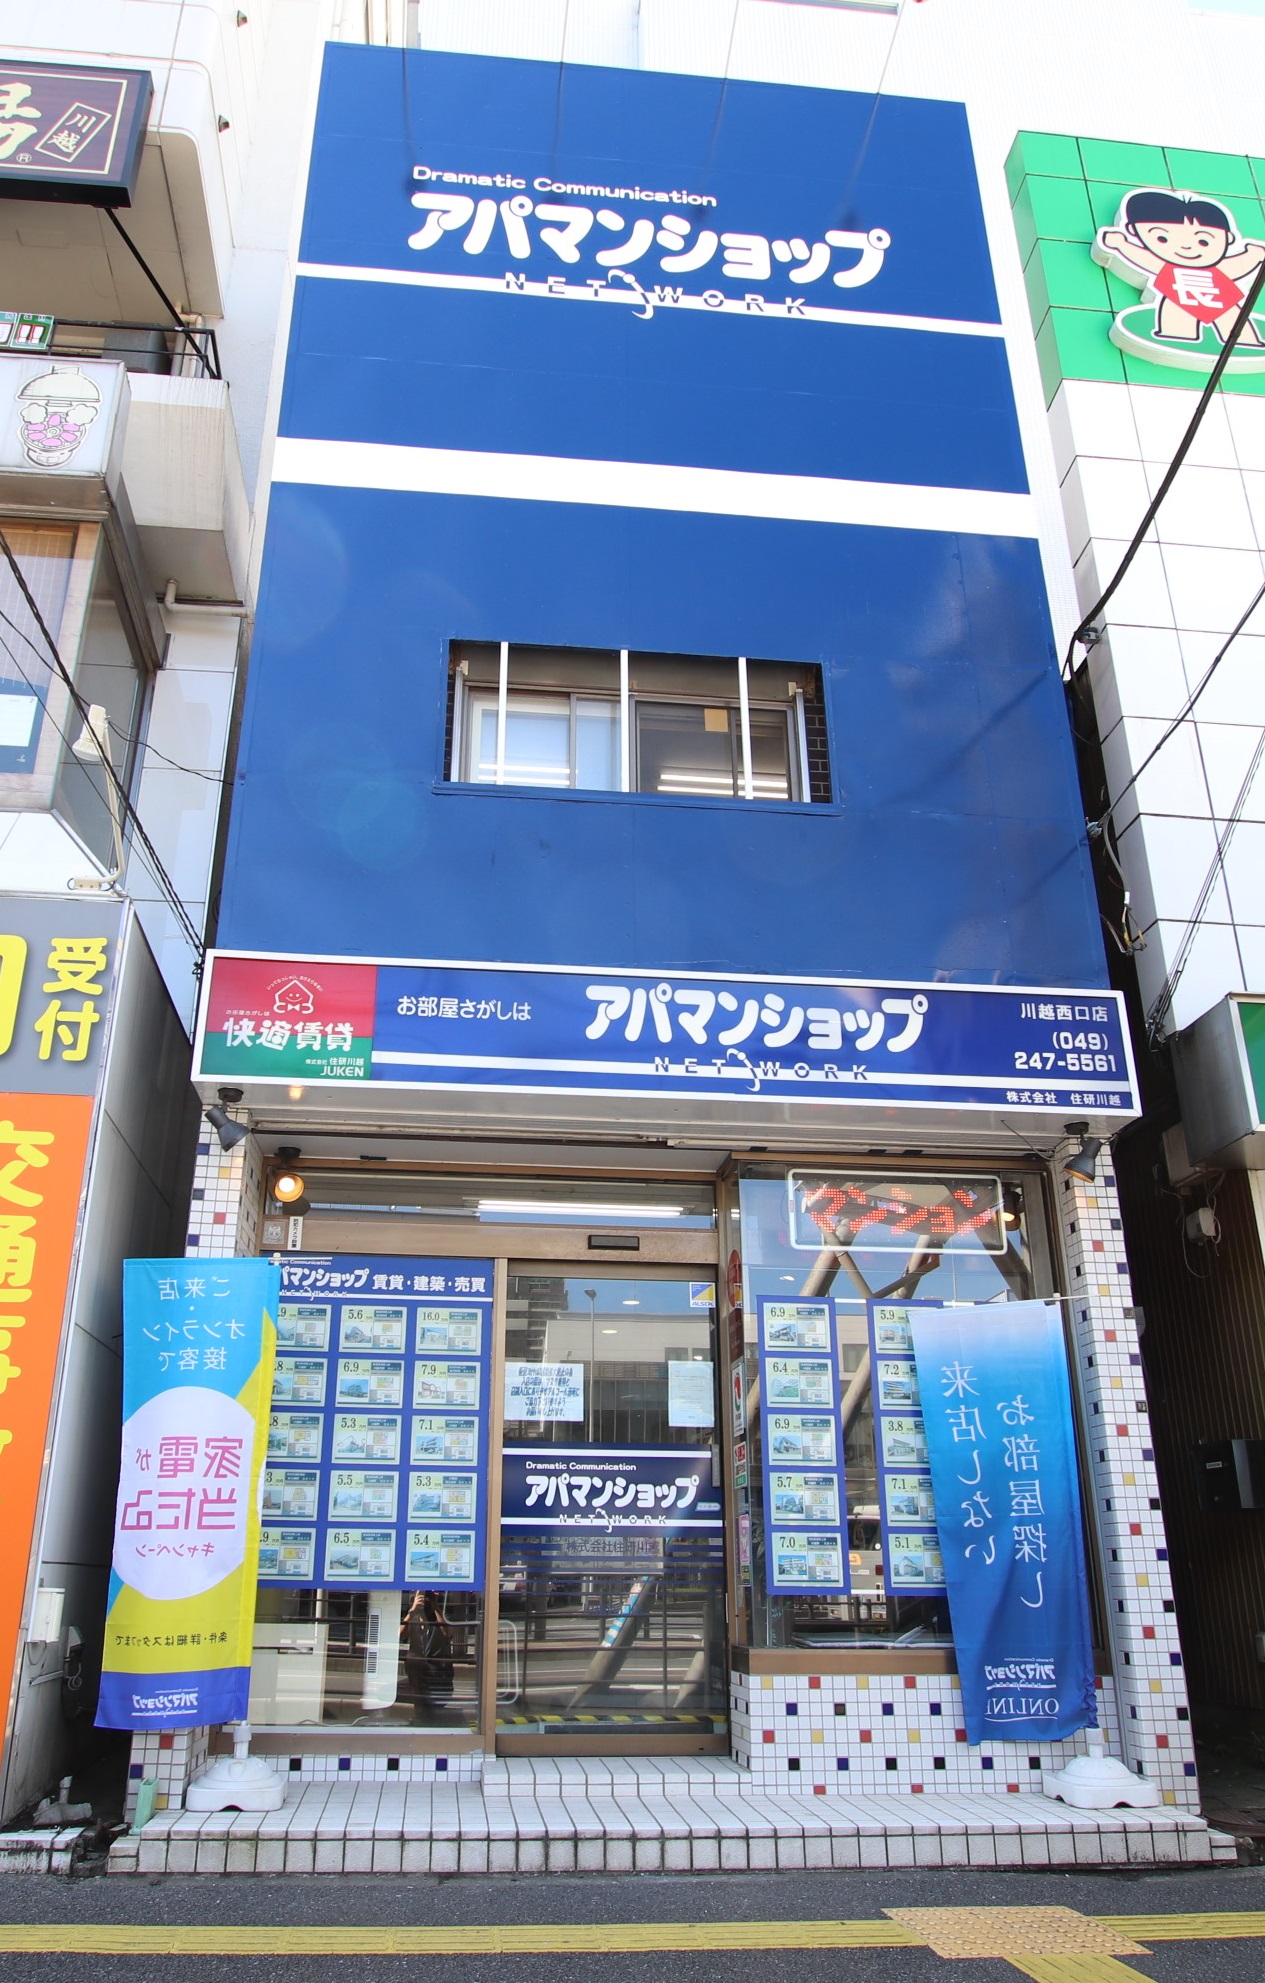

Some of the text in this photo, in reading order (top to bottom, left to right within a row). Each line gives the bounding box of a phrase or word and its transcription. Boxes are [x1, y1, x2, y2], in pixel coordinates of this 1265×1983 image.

[47, 113, 97, 153] 川越
[412, 165, 717, 207] Dramatic Communication
[408, 192, 891, 289] アパマンショップ
[1172, 268, 1224, 309] 長
[34, 937, 108, 1061] 受付
[397, 995, 531, 1021] お部屋さがしは
[1021, 1003, 1108, 1022] 川越西口店
[585, 982, 929, 1053] アパマンショップ
[222, 1017, 354, 1051] 快適賃貸
[1052, 1032, 1108, 1050] (049)
[330, 1057, 365, 1065] 住研川越
[1014, 1051, 1117, 1072] 247-5561
[320, 1066, 364, 1077] JUKEN
[1006, 1091, 1121, 1106] 株式会社 住研川越
[804, 1186, 992, 1236] マンション
[281, 1266, 370, 1288] パマンショップ
[348, 1309, 363, 1320] 5.6
[422, 1311, 440, 1321] 16.0
[770, 1307, 785, 1317] 6.9
[880, 1310, 895, 1320] 5.9
[343, 1362, 359, 1372] 6.9
[421, 1364, 436, 1375] 7.9
[772, 1362, 788, 1372] 6.4
[884, 1364, 899, 1375] 7.2
[340, 1418, 356, 1429] 5.3
[418, 1419, 433, 1430] 7.1
[774, 1418, 790, 1430] 6.9
[888, 1420, 903, 1431] 3.8
[525, 1461, 637, 1471] Dramatic Communication
[337, 1475, 353, 1486] 5.5
[416, 1476, 431, 1487] 5.3
[777, 1476, 792, 1488] 5.7
[891, 1478, 906, 1490] 7.1
[525, 1472, 700, 1509] アパマンショップ
[333, 1532, 349, 1544] 6.5
[413, 1534, 429, 1545] 5.4
[779, 1537, 795, 1548] 7.0
[894, 1537, 909, 1548] 5.1
